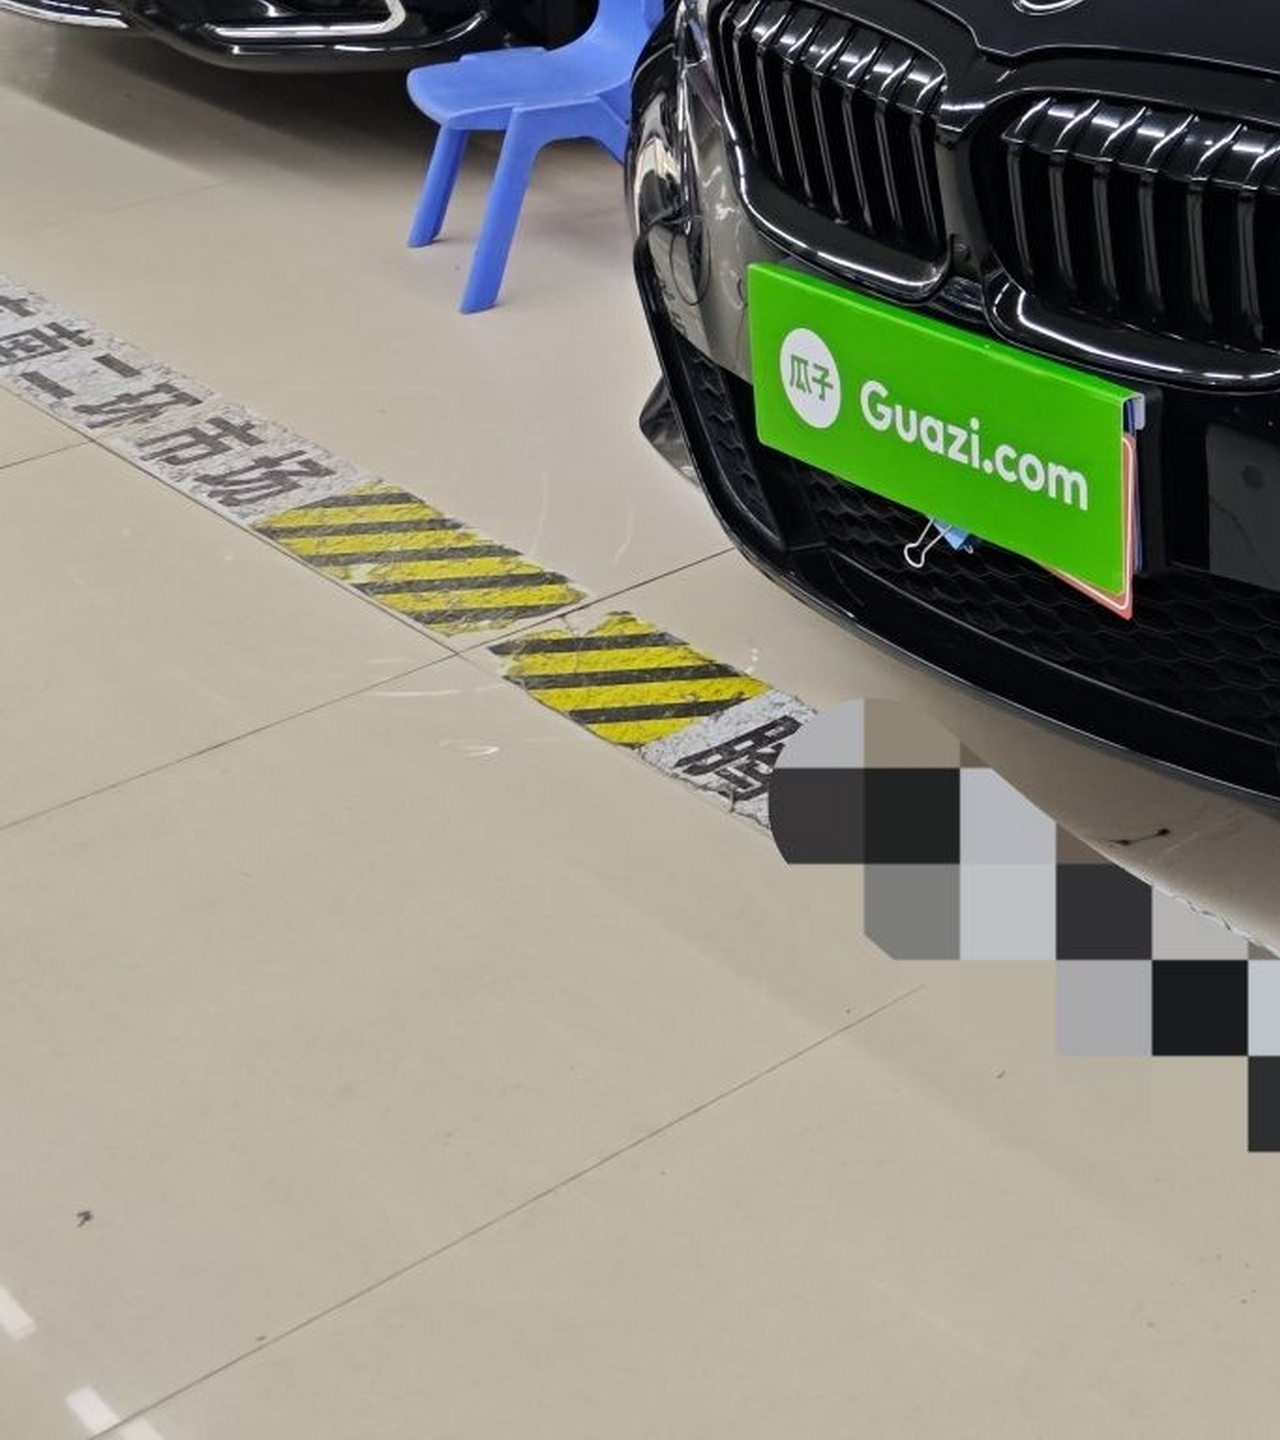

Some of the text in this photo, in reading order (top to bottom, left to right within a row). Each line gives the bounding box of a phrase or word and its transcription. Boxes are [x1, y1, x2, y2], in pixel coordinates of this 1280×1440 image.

[0, 295, 337, 508] 南二环市场
[789, 353, 1089, 512] 瓜子 Guazi.com
